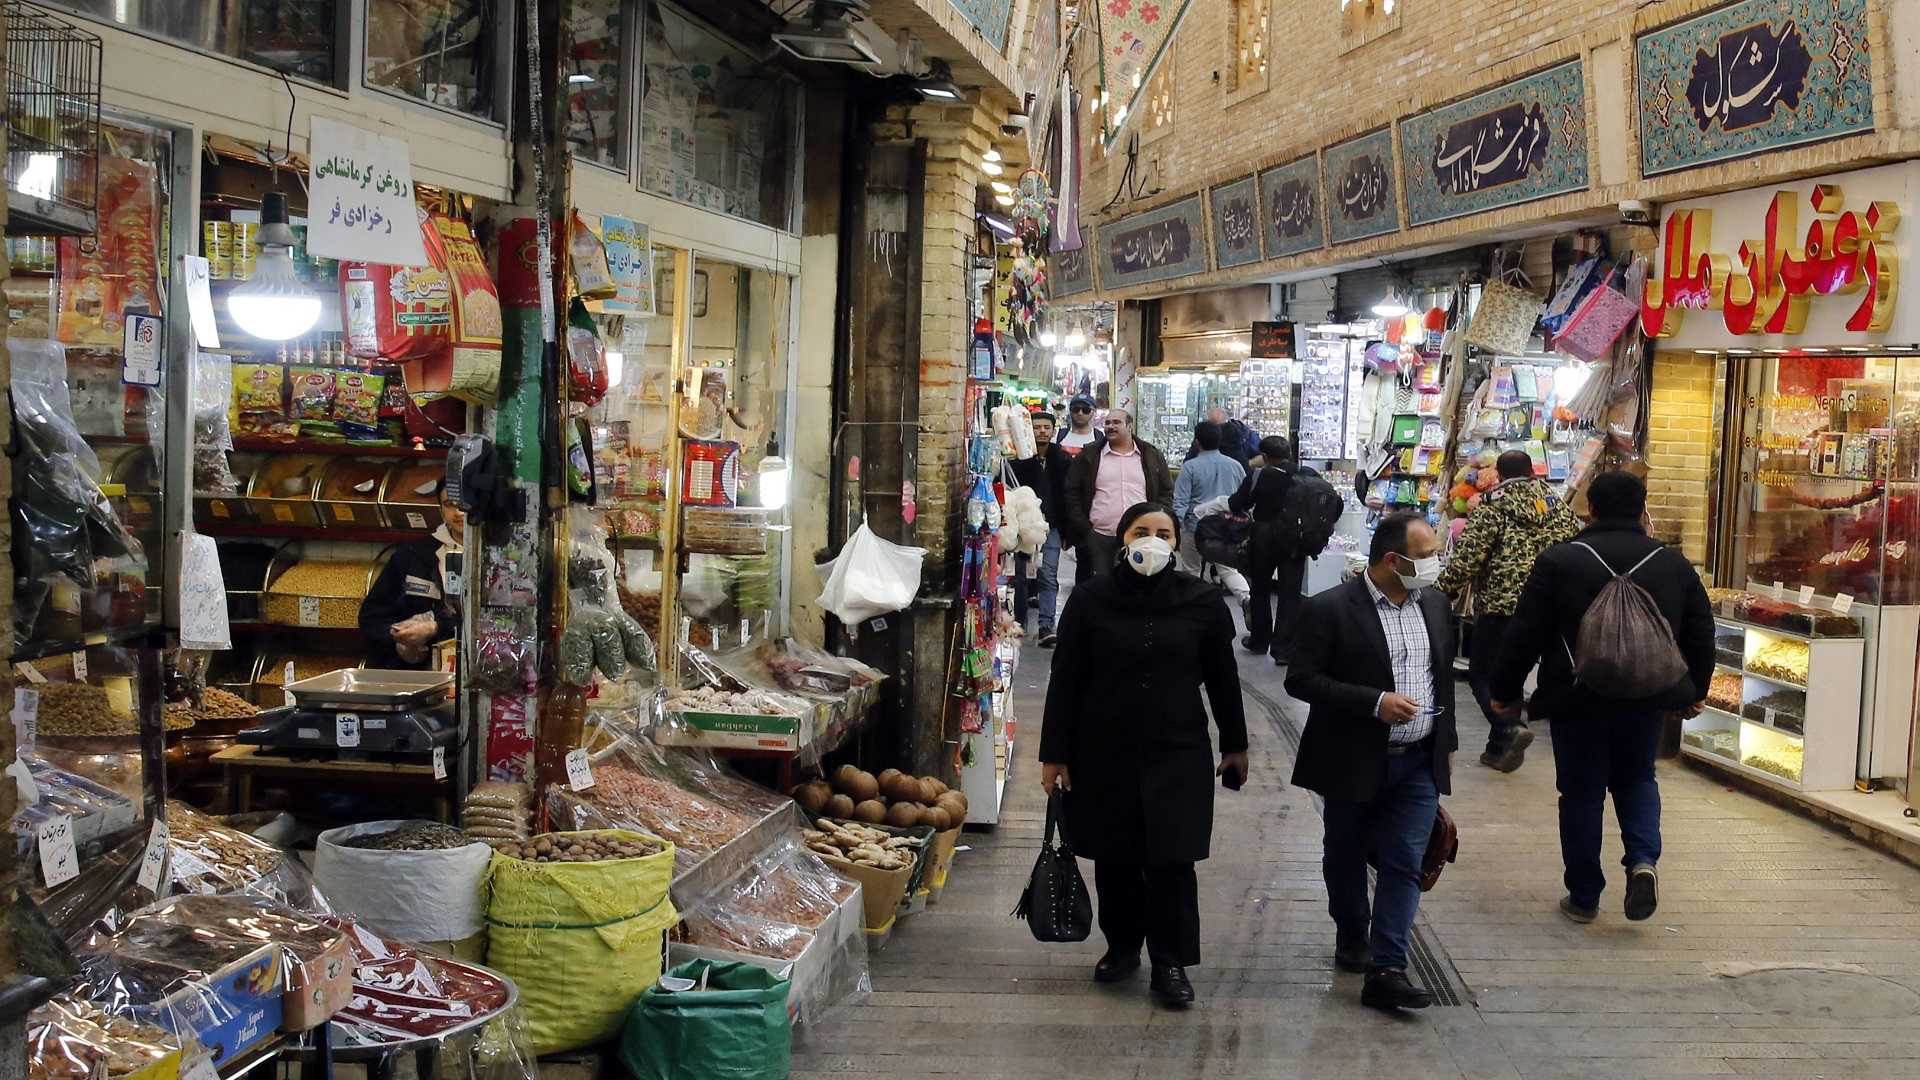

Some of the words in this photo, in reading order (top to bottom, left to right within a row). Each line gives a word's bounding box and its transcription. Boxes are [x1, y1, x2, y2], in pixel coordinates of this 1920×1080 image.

[315, 155, 374, 189] کرمانشاهی
[376, 169, 408, 198] روغن
[328, 195, 342, 225] فر
[1722, 184, 1902, 336] زعفران
